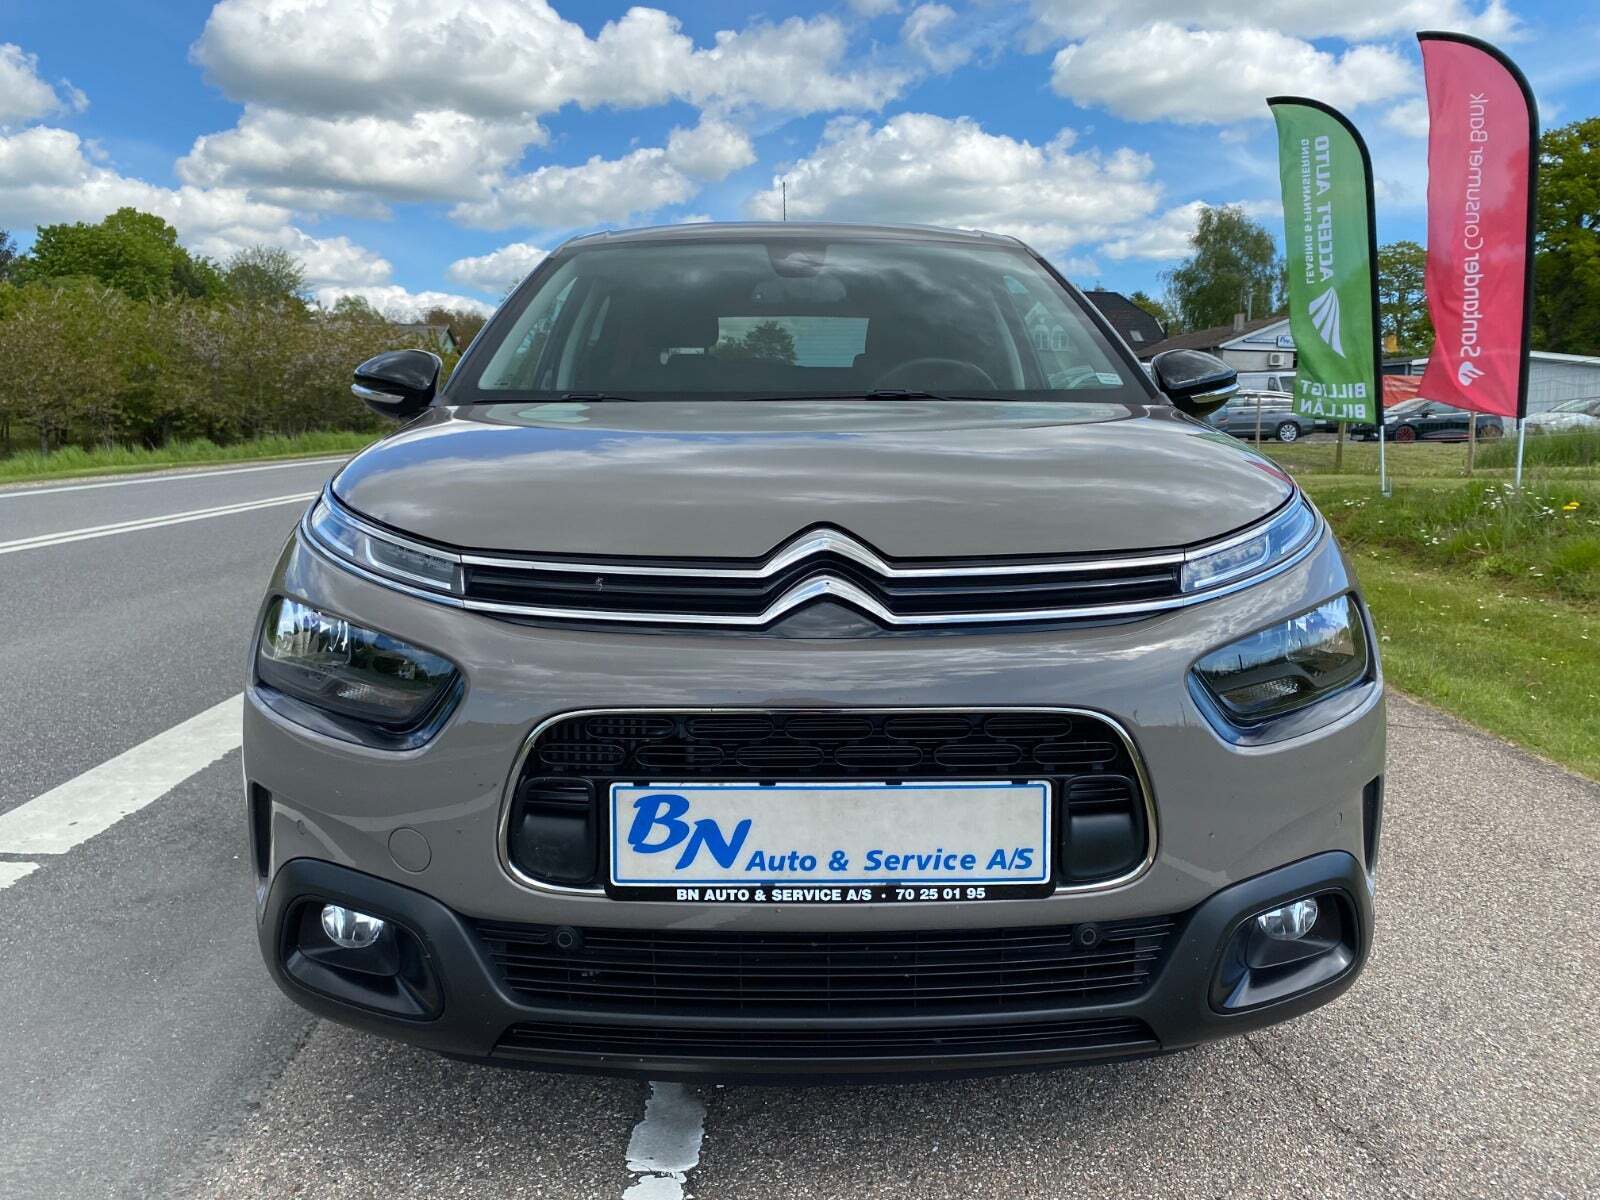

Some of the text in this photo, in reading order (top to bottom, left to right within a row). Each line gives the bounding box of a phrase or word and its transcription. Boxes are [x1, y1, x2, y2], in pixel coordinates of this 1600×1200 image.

[627, 794, 1034, 872] BN Auto & Service A/S
[676, 888, 986, 901] BN AUTO & SERVICE A/S 70 25 01 95
